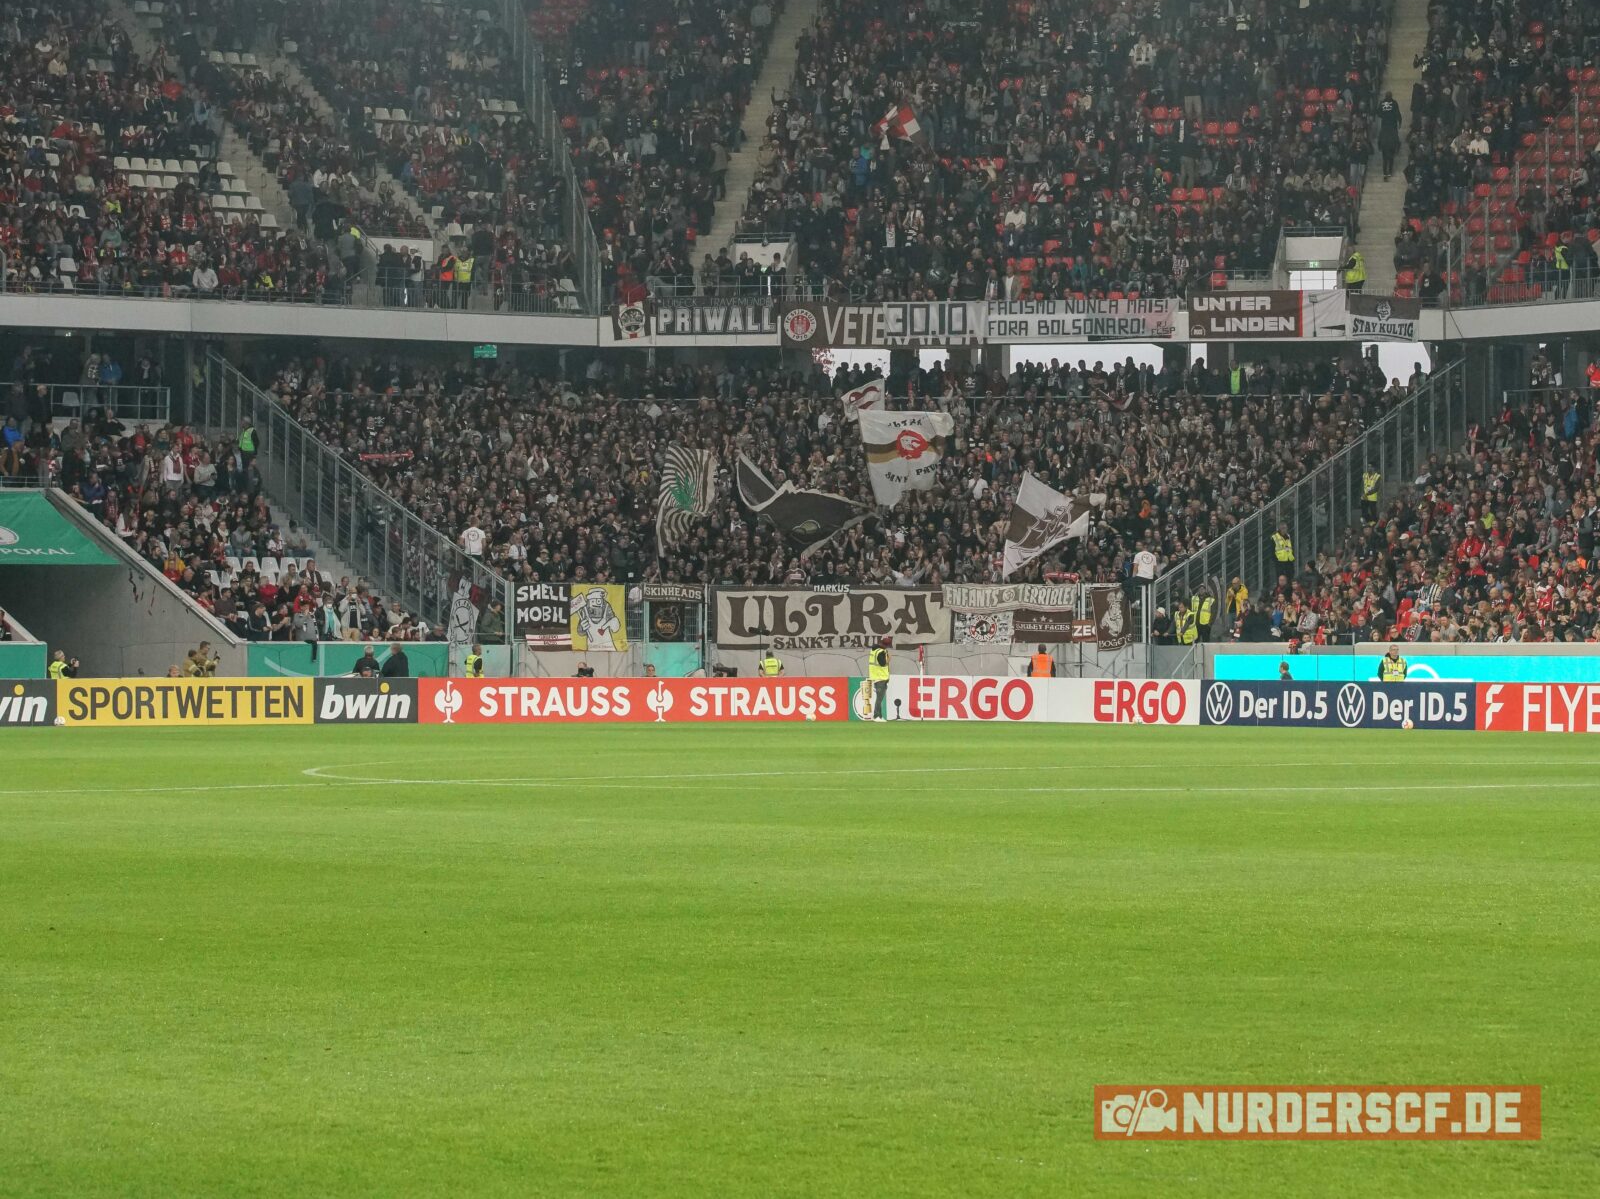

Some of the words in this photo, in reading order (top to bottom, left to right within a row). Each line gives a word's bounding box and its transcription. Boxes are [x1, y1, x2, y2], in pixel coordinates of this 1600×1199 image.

[988, 300, 1056, 315] FACISMO
[1065, 300, 1118, 315] NUNCA
[1127, 299, 1168, 314] MAIS!
[1193, 296, 1271, 311] UNTER
[657, 306, 777, 334] PRIWALL
[988, 319, 1028, 336] FORA
[1038, 318, 1146, 336] BOLSONARO!
[1211, 316, 1295, 332] LINDEN
[1352, 317, 1378, 334] STAY
[516, 583, 569, 602] SHELL
[645, 586, 703, 600] SKINHEADS
[813, 584, 850, 593] MARKUS
[946, 585, 999, 608] ENFANTS
[1016, 584, 1078, 606] TERRIBLES
[516, 607, 568, 625] MOBIL
[773, 636, 835, 649] SANKT
[68, 685, 304, 720] SPORTWETTEN
[320, 682, 411, 720] bwin
[479, 686, 630, 716] STRAUSS
[690, 685, 836, 717] STRAUSS
[908, 677, 1034, 721] ERGO
[1094, 680, 1187, 724] ERGO
[1239, 690, 1277, 719] Der
[1283, 690, 1327, 720] ID.5
[1372, 691, 1414, 721] Der
[1420, 692, 1468, 722] ID.5
